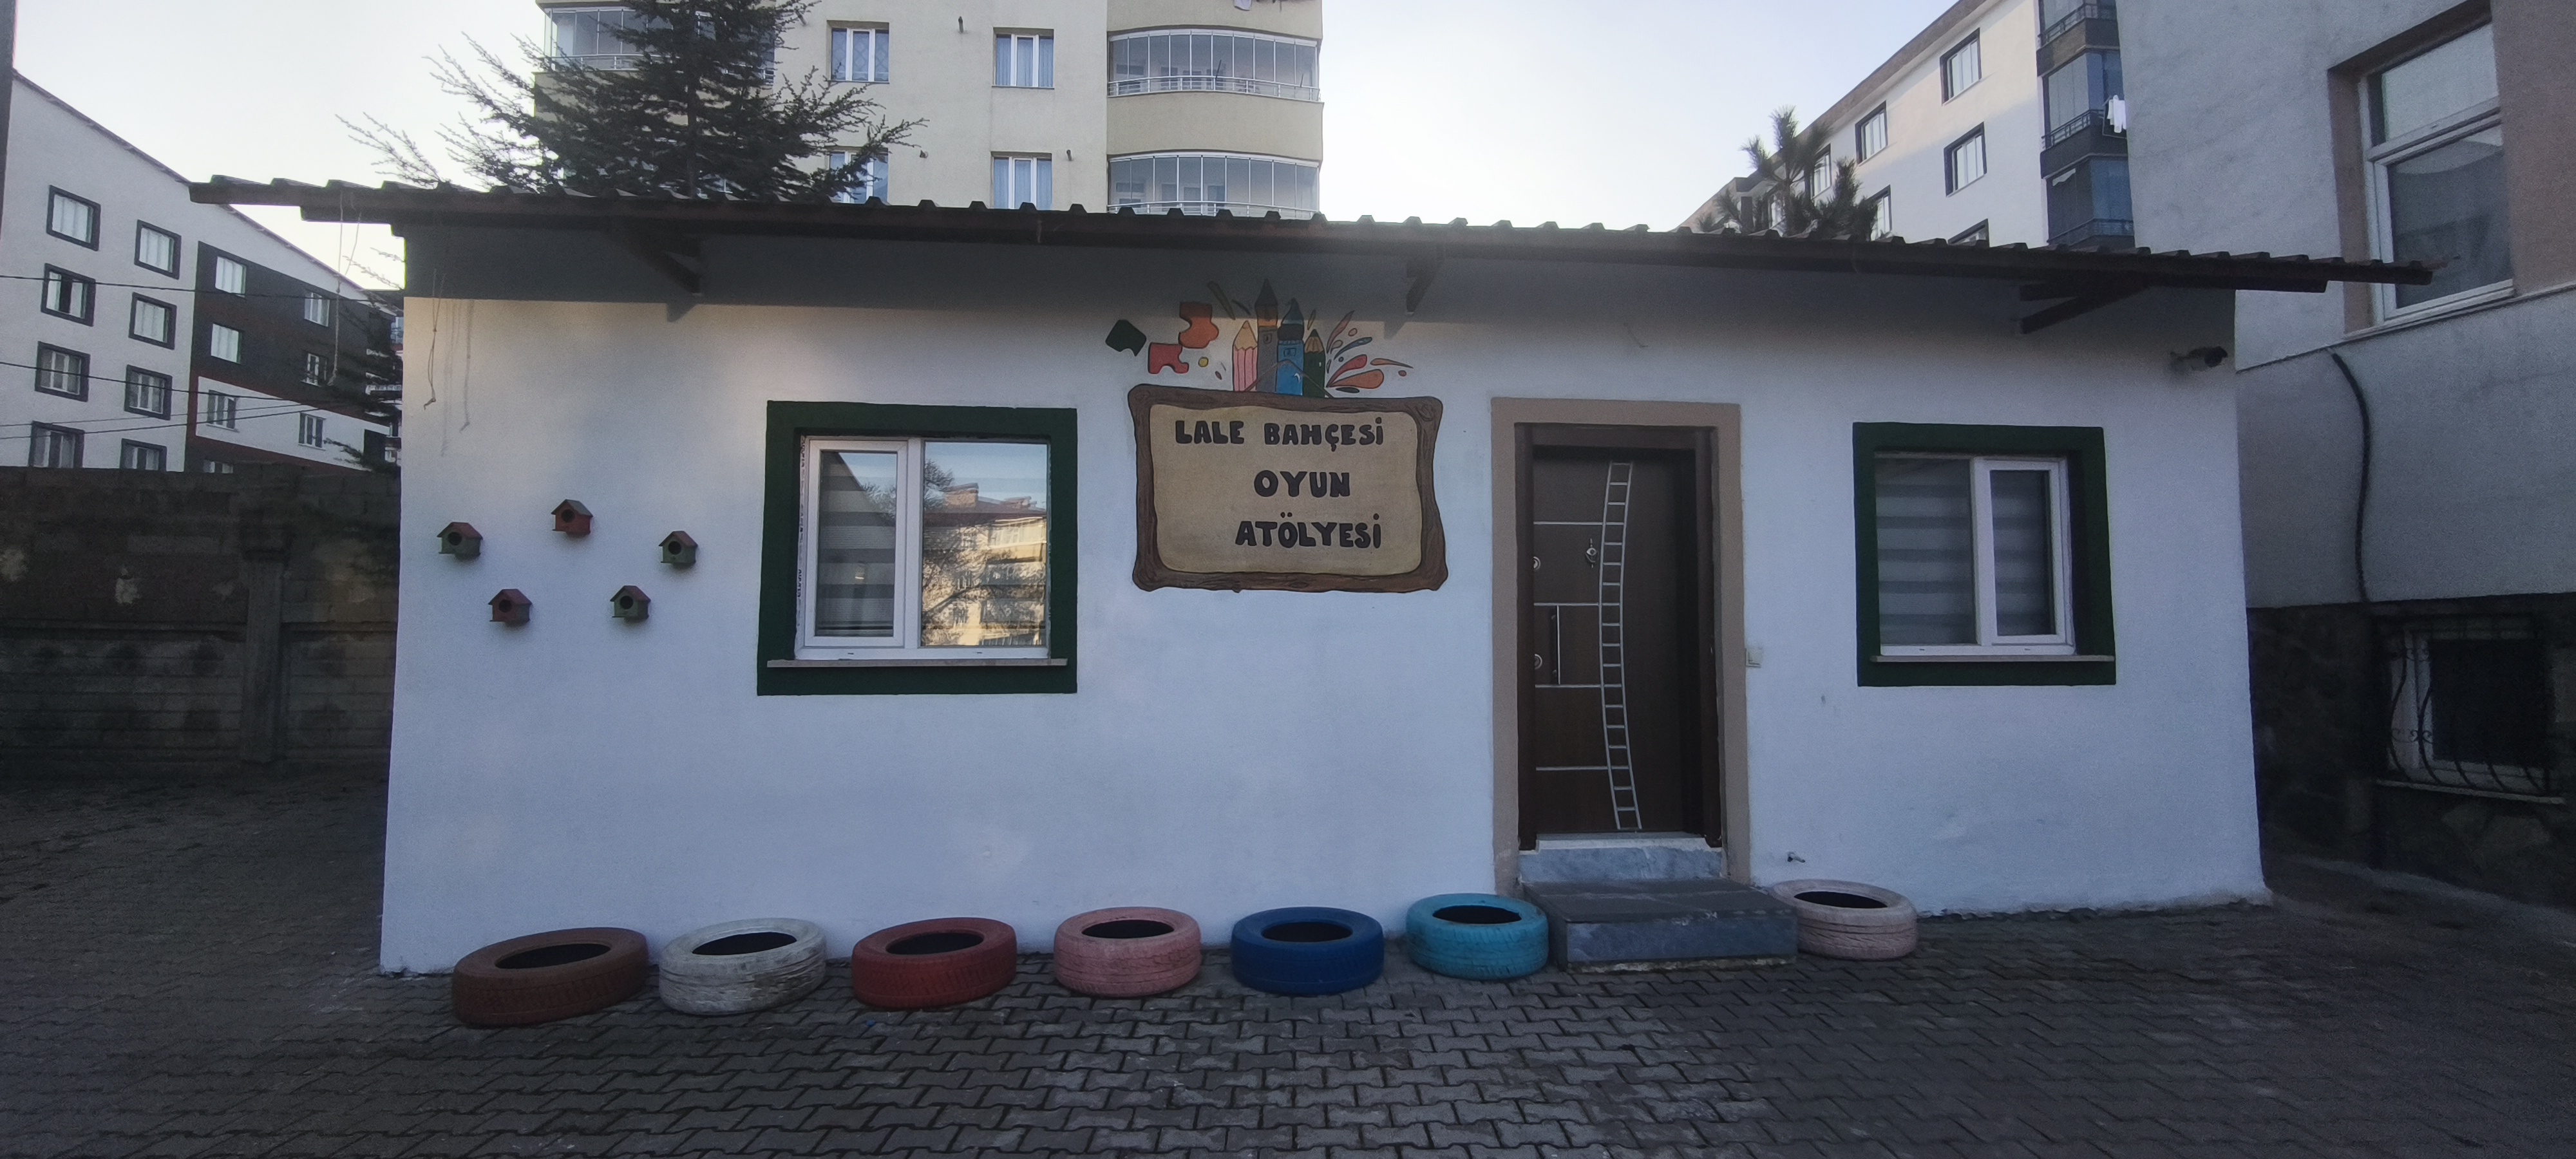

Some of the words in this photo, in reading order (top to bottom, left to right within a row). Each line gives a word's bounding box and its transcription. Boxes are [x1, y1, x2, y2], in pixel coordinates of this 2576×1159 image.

[1175, 420, 1244, 444] LALE
[1264, 417, 1383, 451] BAHÇESİ
[1254, 470, 1350, 498] OYUN
[1235, 512, 1381, 549] ATÖLYESİ
